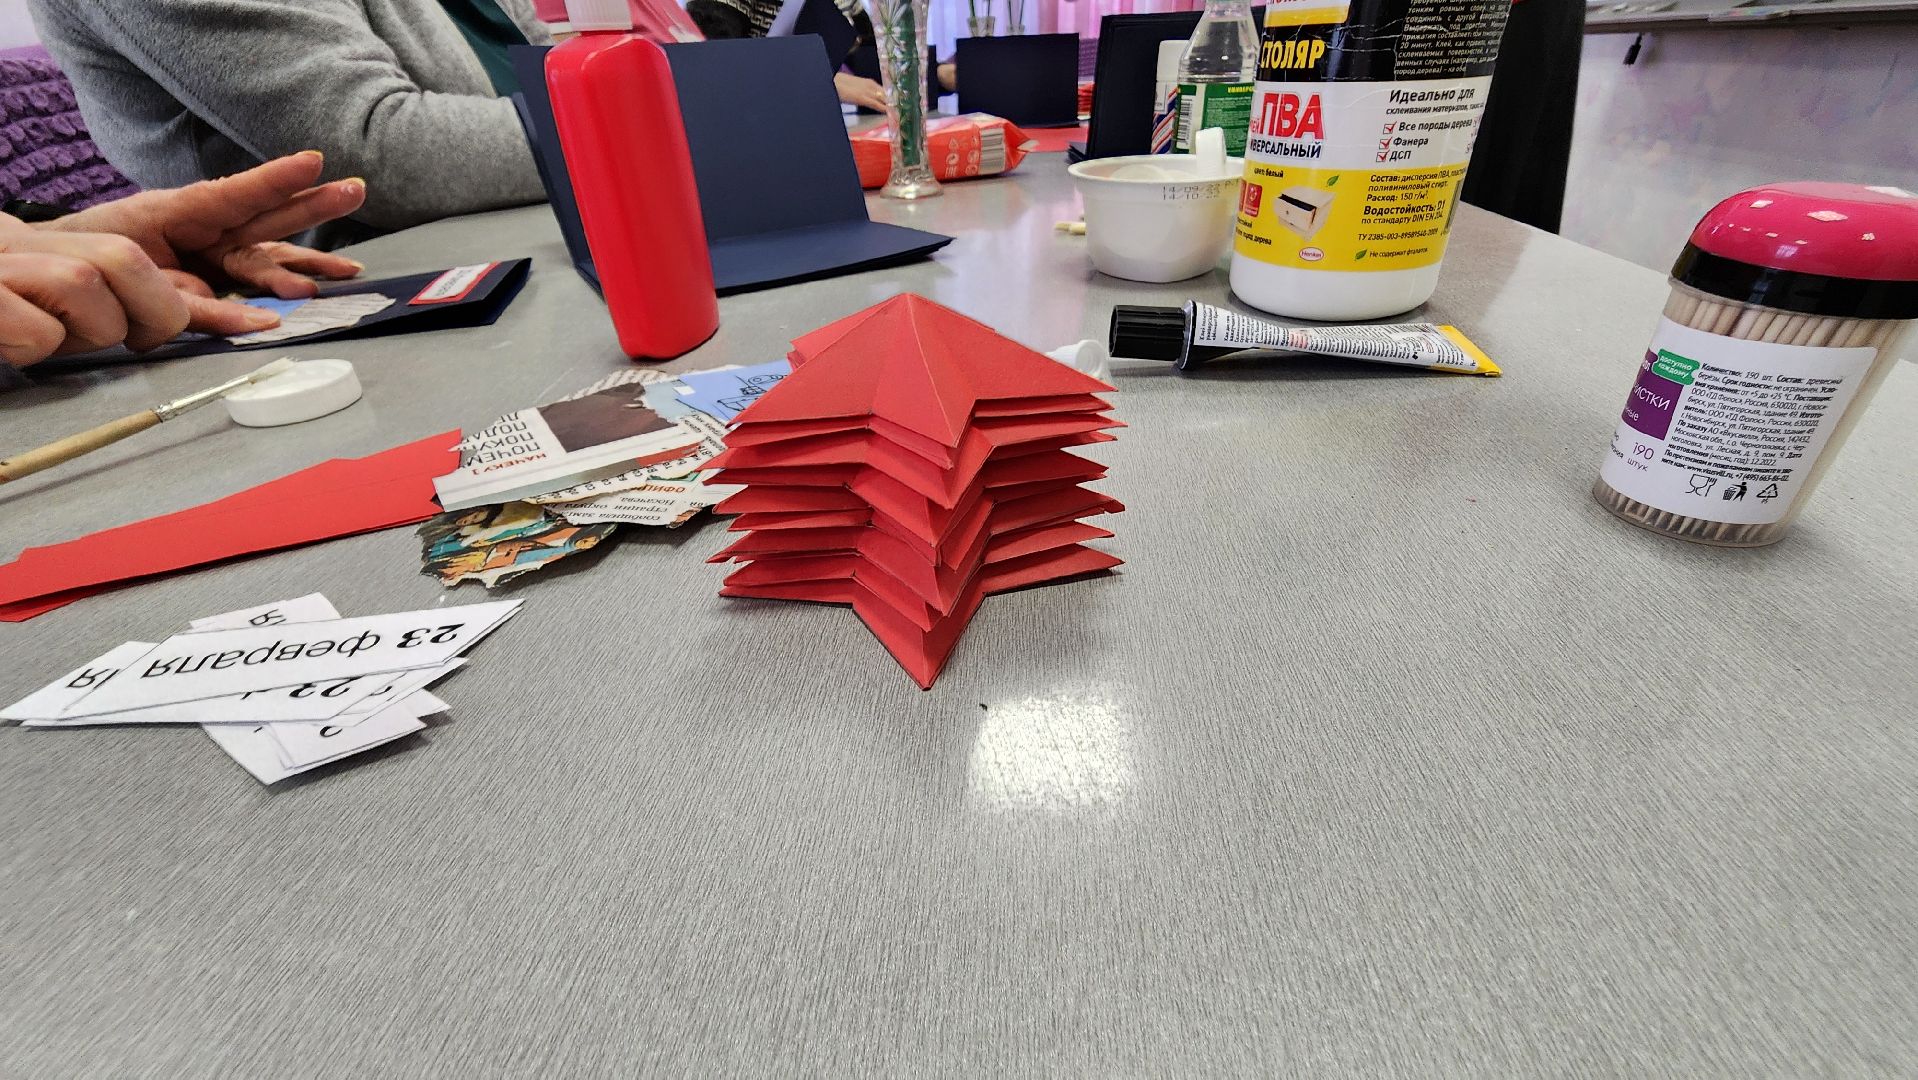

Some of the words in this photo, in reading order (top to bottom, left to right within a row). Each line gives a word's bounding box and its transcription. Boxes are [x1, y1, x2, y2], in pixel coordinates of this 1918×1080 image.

[1455, 14, 1476, 22] другой
[1411, 42, 1433, 50] минут.
[1435, 40, 1452, 48] Клей,
[1260, 39, 1325, 69] СТОЛЯР
[1425, 58, 1450, 66] случаях
[1389, 89, 1455, 105] Идеально
[1457, 88, 1475, 102] для
[1259, 92, 1324, 140] ПВА
[1386, 106, 1431, 115] склеивания
[1432, 104, 1469, 113] материалов,
[1398, 122, 1416, 131] Все
[1418, 120, 1450, 131] породы
[1451, 119, 1472, 129] дерева
[1393, 137, 1429, 147] Фанера
[1389, 150, 1411, 162] ДСП
[1370, 174, 1401, 183] Состав:
[1401, 172, 1438, 183] дисперсия
[1437, 171, 1450, 179] ПВА,
[1368, 181, 1431, 192] поливиниловый
[1431, 180, 1449, 188] спирт.
[1366, 193, 1398, 202] Расход:
[1400, 192, 1413, 200] 150
[1363, 203, 1436, 216] Водостойкость:
[1437, 200, 1446, 211] D1
[1373, 215, 1411, 225] стандарту
[1412, 214, 1424, 223] DIN
[1425, 212, 1434, 221] EN
[1358, 233, 1367, 241] ТУ
[1301, 250, 1322, 258] Henkel
[1379, 249, 1406, 258] содержит
[1702, 363, 1742, 378] Количество:
[1745, 371, 1759, 379] 190
[1722, 376, 1739, 386] Срок
[1691, 387, 1706, 397] ООО
[1744, 398, 1769, 408] Россия,
[1770, 401, 1797, 410] 630020,
[1687, 396, 1707, 408] бирск,
[1707, 400, 1716, 409] ул.
[1717, 401, 1761, 416] Пятигорская,
[1683, 405, 1708, 415] витель:
[1708, 409, 1725, 419] ООО
[1767, 419, 1793, 427] Россия,
[1685, 413, 1727, 429] Новосибирск,
[1728, 422, 1738, 430] ул.
[1739, 423, 1783, 435] Пятигорская,
[1677, 419, 1687, 427] По
[1687, 422, 1707, 433] заказу
[1708, 424, 1719, 435] АО
[1761, 434, 1786, 443] Россия,
[1674, 427, 1710, 441] Московская
[1739, 440, 1786, 451] Черноголовка,
[1632, 441, 1654, 460] 190
[1667, 443, 1709, 458] изготовления
[1671, 436, 1702, 449] ноголовка,
[1705, 443, 1715, 451] ул.
[1716, 445, 1742, 456] Лесная,
[483, 452, 547, 473] НАЧЕКУ
[1627, 458, 1649, 472] штук
[1742, 473, 1758, 481] (495)
[564, 502, 608, 510] округа
[613, 504, 668, 513] страции
[598, 512, 661, 521] сообщила
[396, 622, 466, 649] 23
[140, 630, 381, 680] февраля
